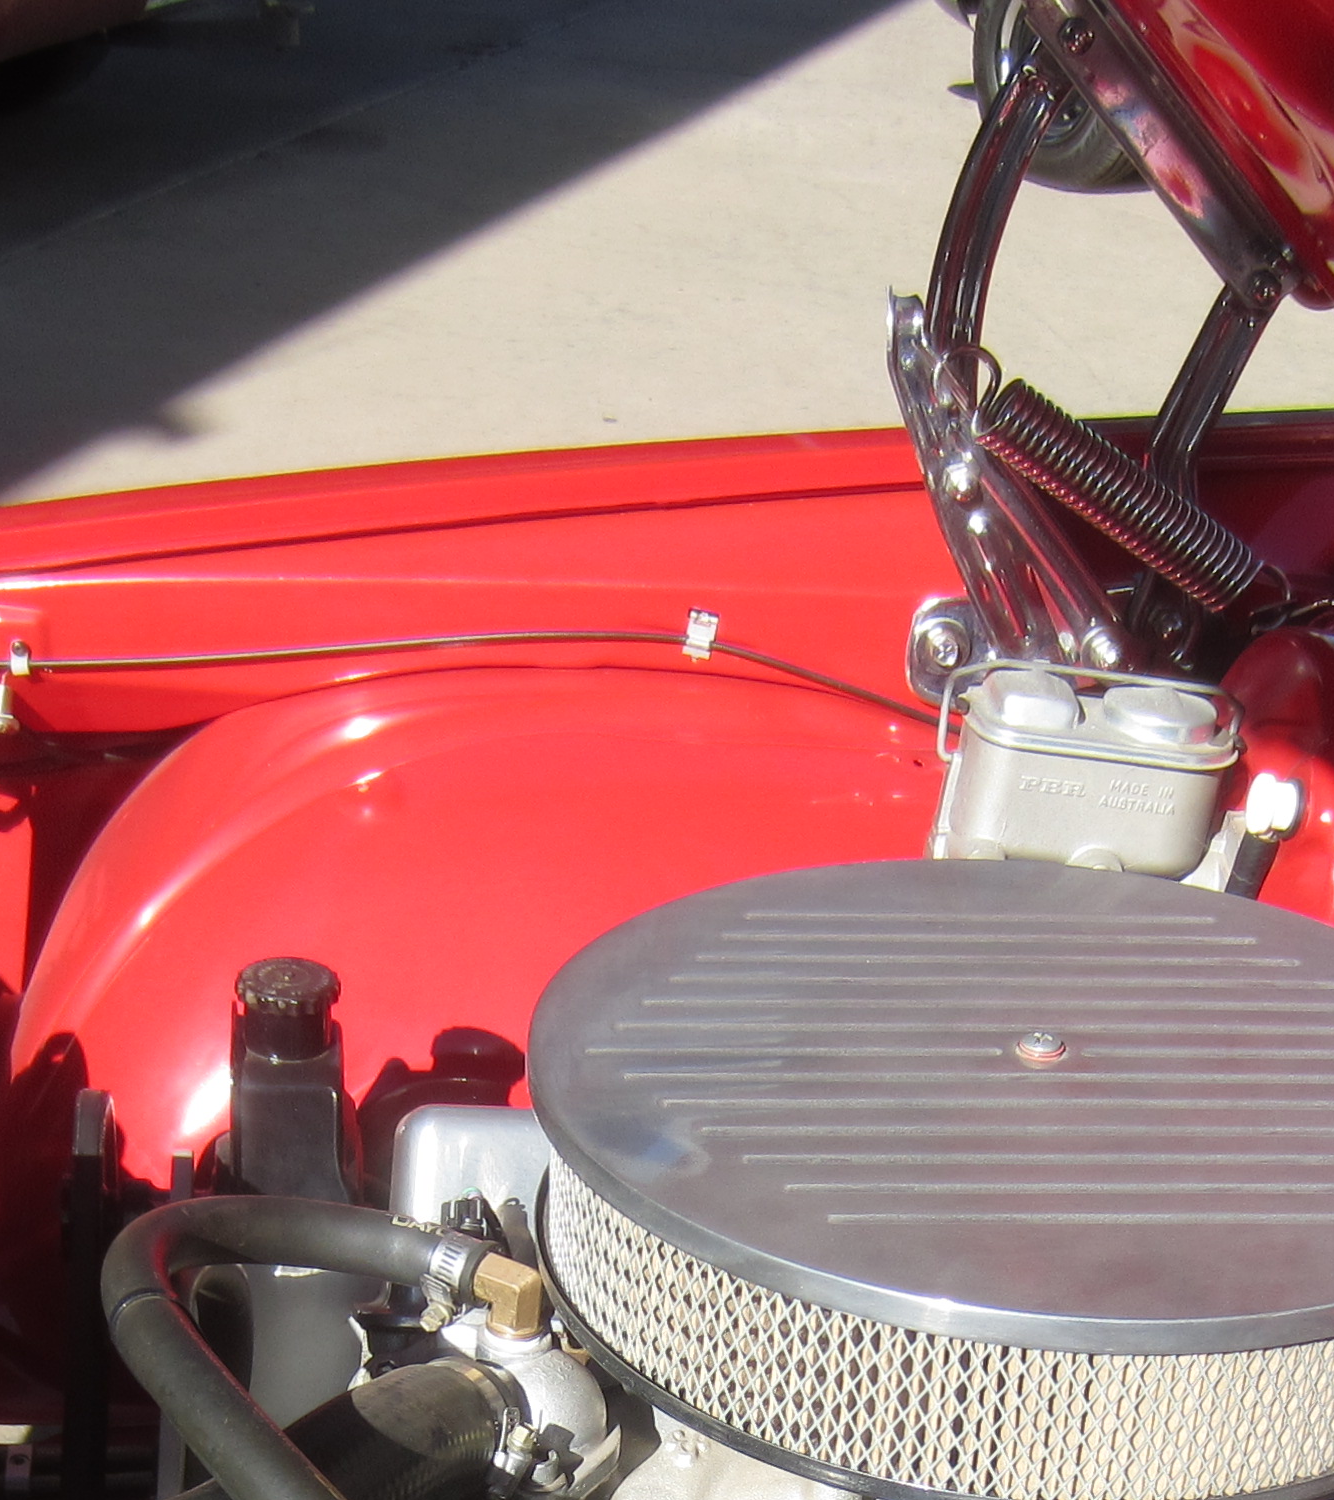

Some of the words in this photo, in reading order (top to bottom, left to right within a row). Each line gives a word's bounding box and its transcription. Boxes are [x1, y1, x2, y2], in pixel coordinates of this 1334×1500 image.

[1018, 775, 1086, 797] PBR
[1109, 779, 1149, 796] MADE
[1158, 785, 1174, 799] IN
[1098, 795, 1175, 815] AUSTRALIA
